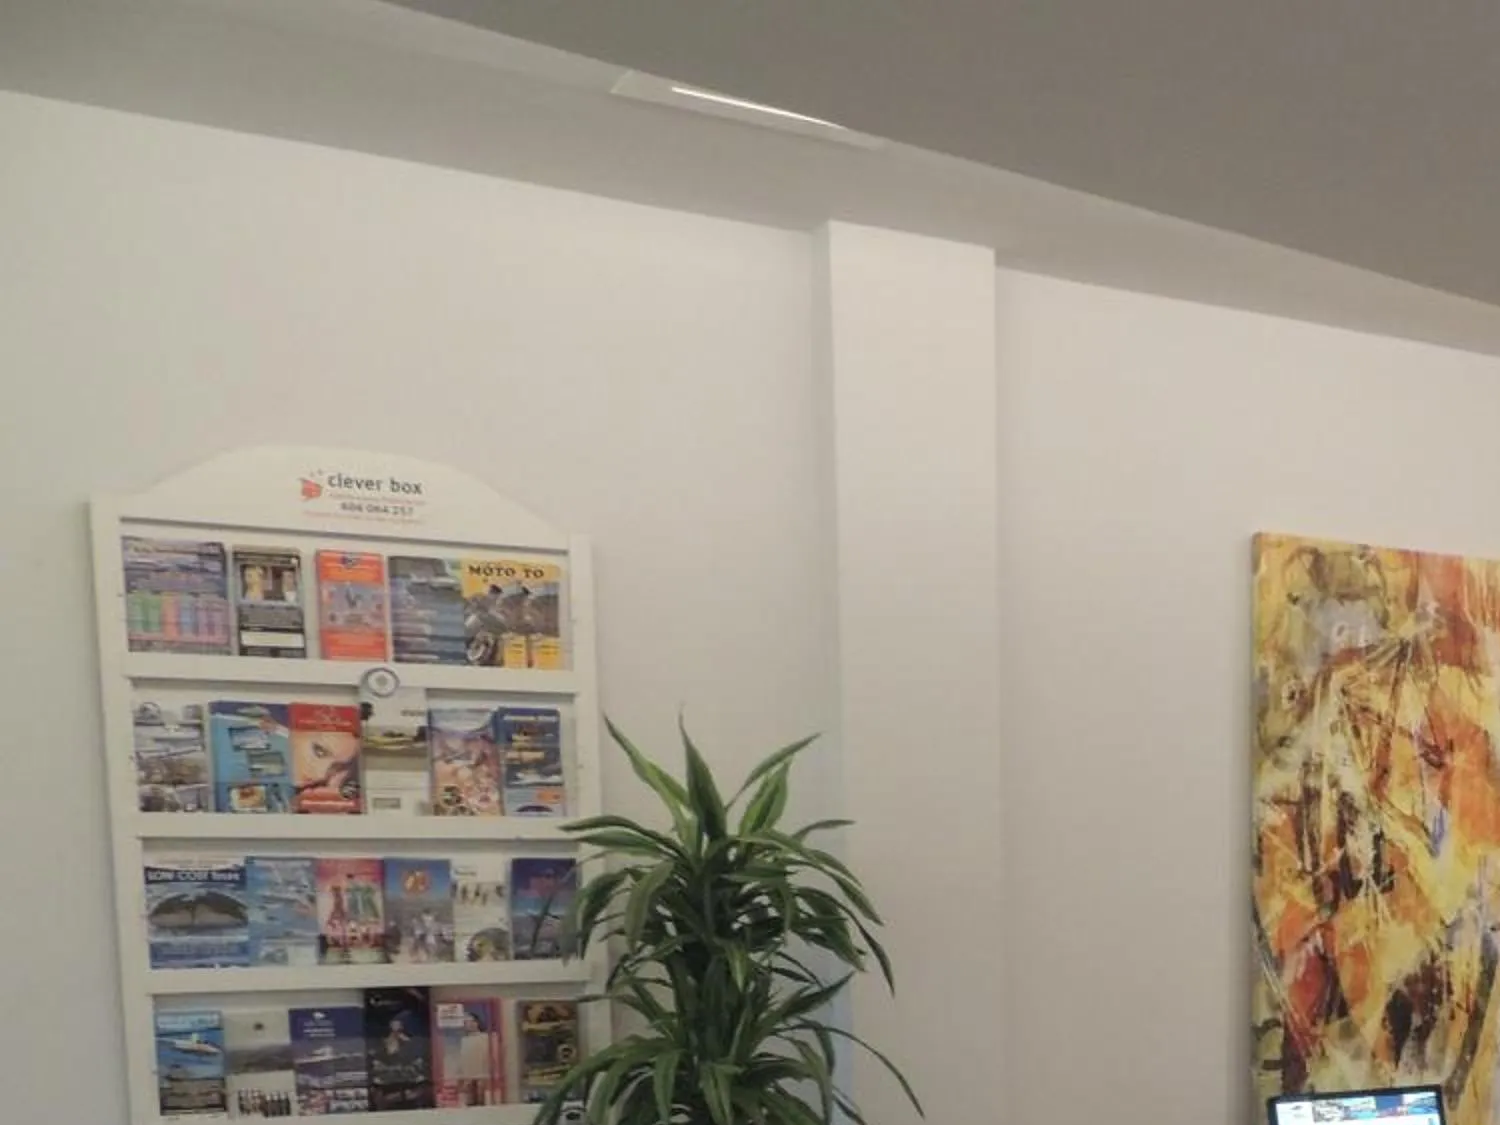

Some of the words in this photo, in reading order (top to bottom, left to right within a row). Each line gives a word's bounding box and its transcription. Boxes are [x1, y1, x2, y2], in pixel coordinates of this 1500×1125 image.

[327, 472, 383, 491] clever
[389, 476, 422, 494] box
[467, 565, 516, 577] MOTO
[523, 567, 545, 579] TO
